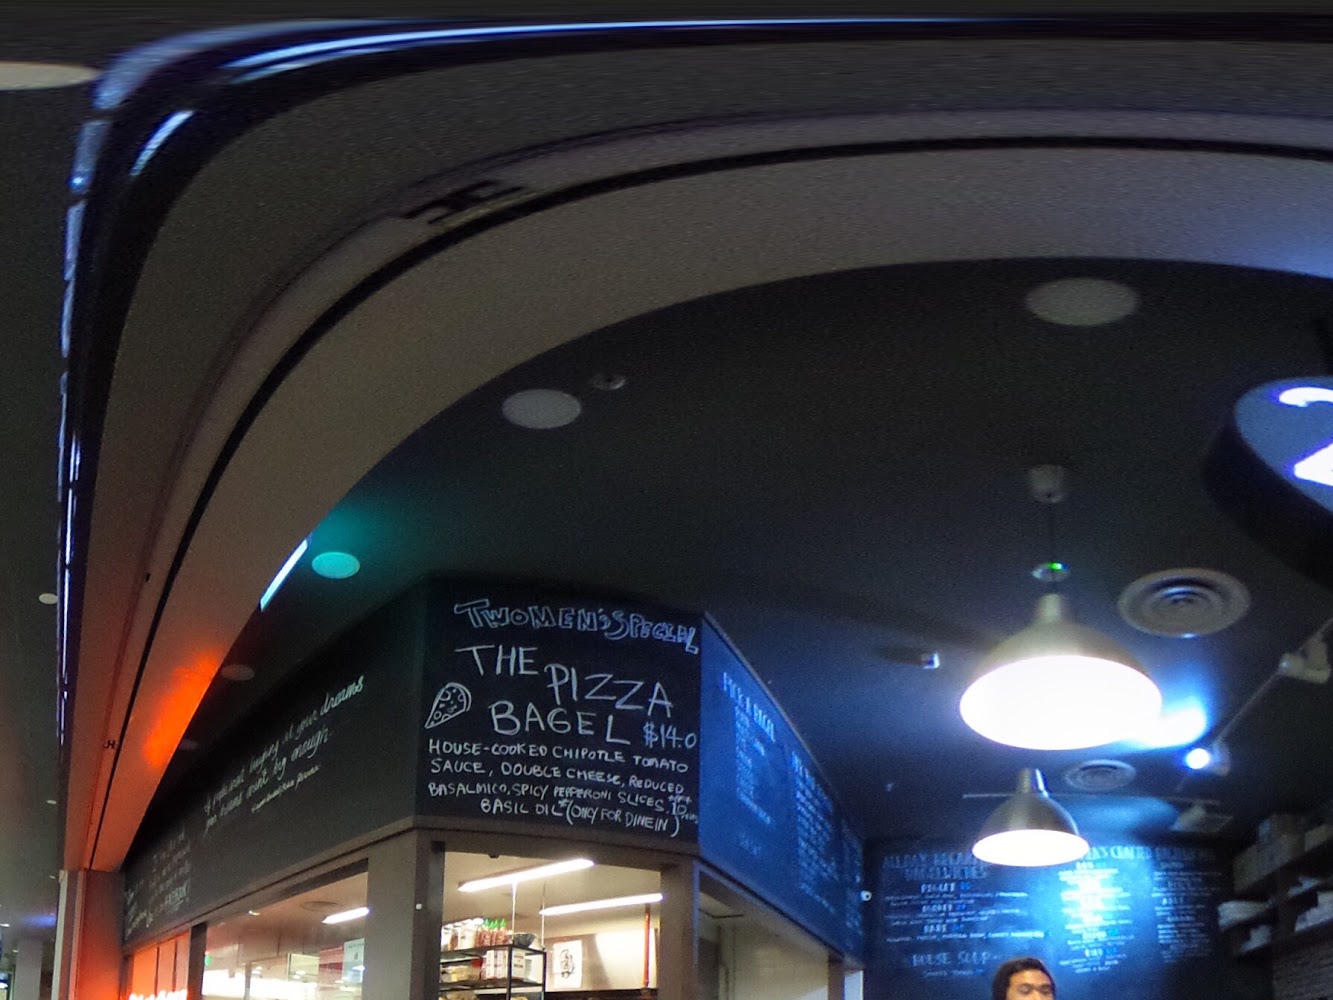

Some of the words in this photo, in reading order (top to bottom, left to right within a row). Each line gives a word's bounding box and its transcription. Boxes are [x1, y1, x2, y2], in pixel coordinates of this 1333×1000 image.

[454, 644, 538, 676] THE
[320, 675, 364, 717] dreams
[543, 663, 673, 718] PIZZA
[488, 700, 631, 744] BAGEL
[430, 758, 494, 777] SAUCE,
[501, 761, 561, 779] DOUBLE
[552, 746, 626, 763] CHIPOTLE
[633, 754, 688, 773] TOMATO
[512, 783, 549, 801] SPICY
[553, 786, 612, 801] PEPPERONI
[480, 799, 529, 814] BASIL
[601, 808, 621, 823] FOR
